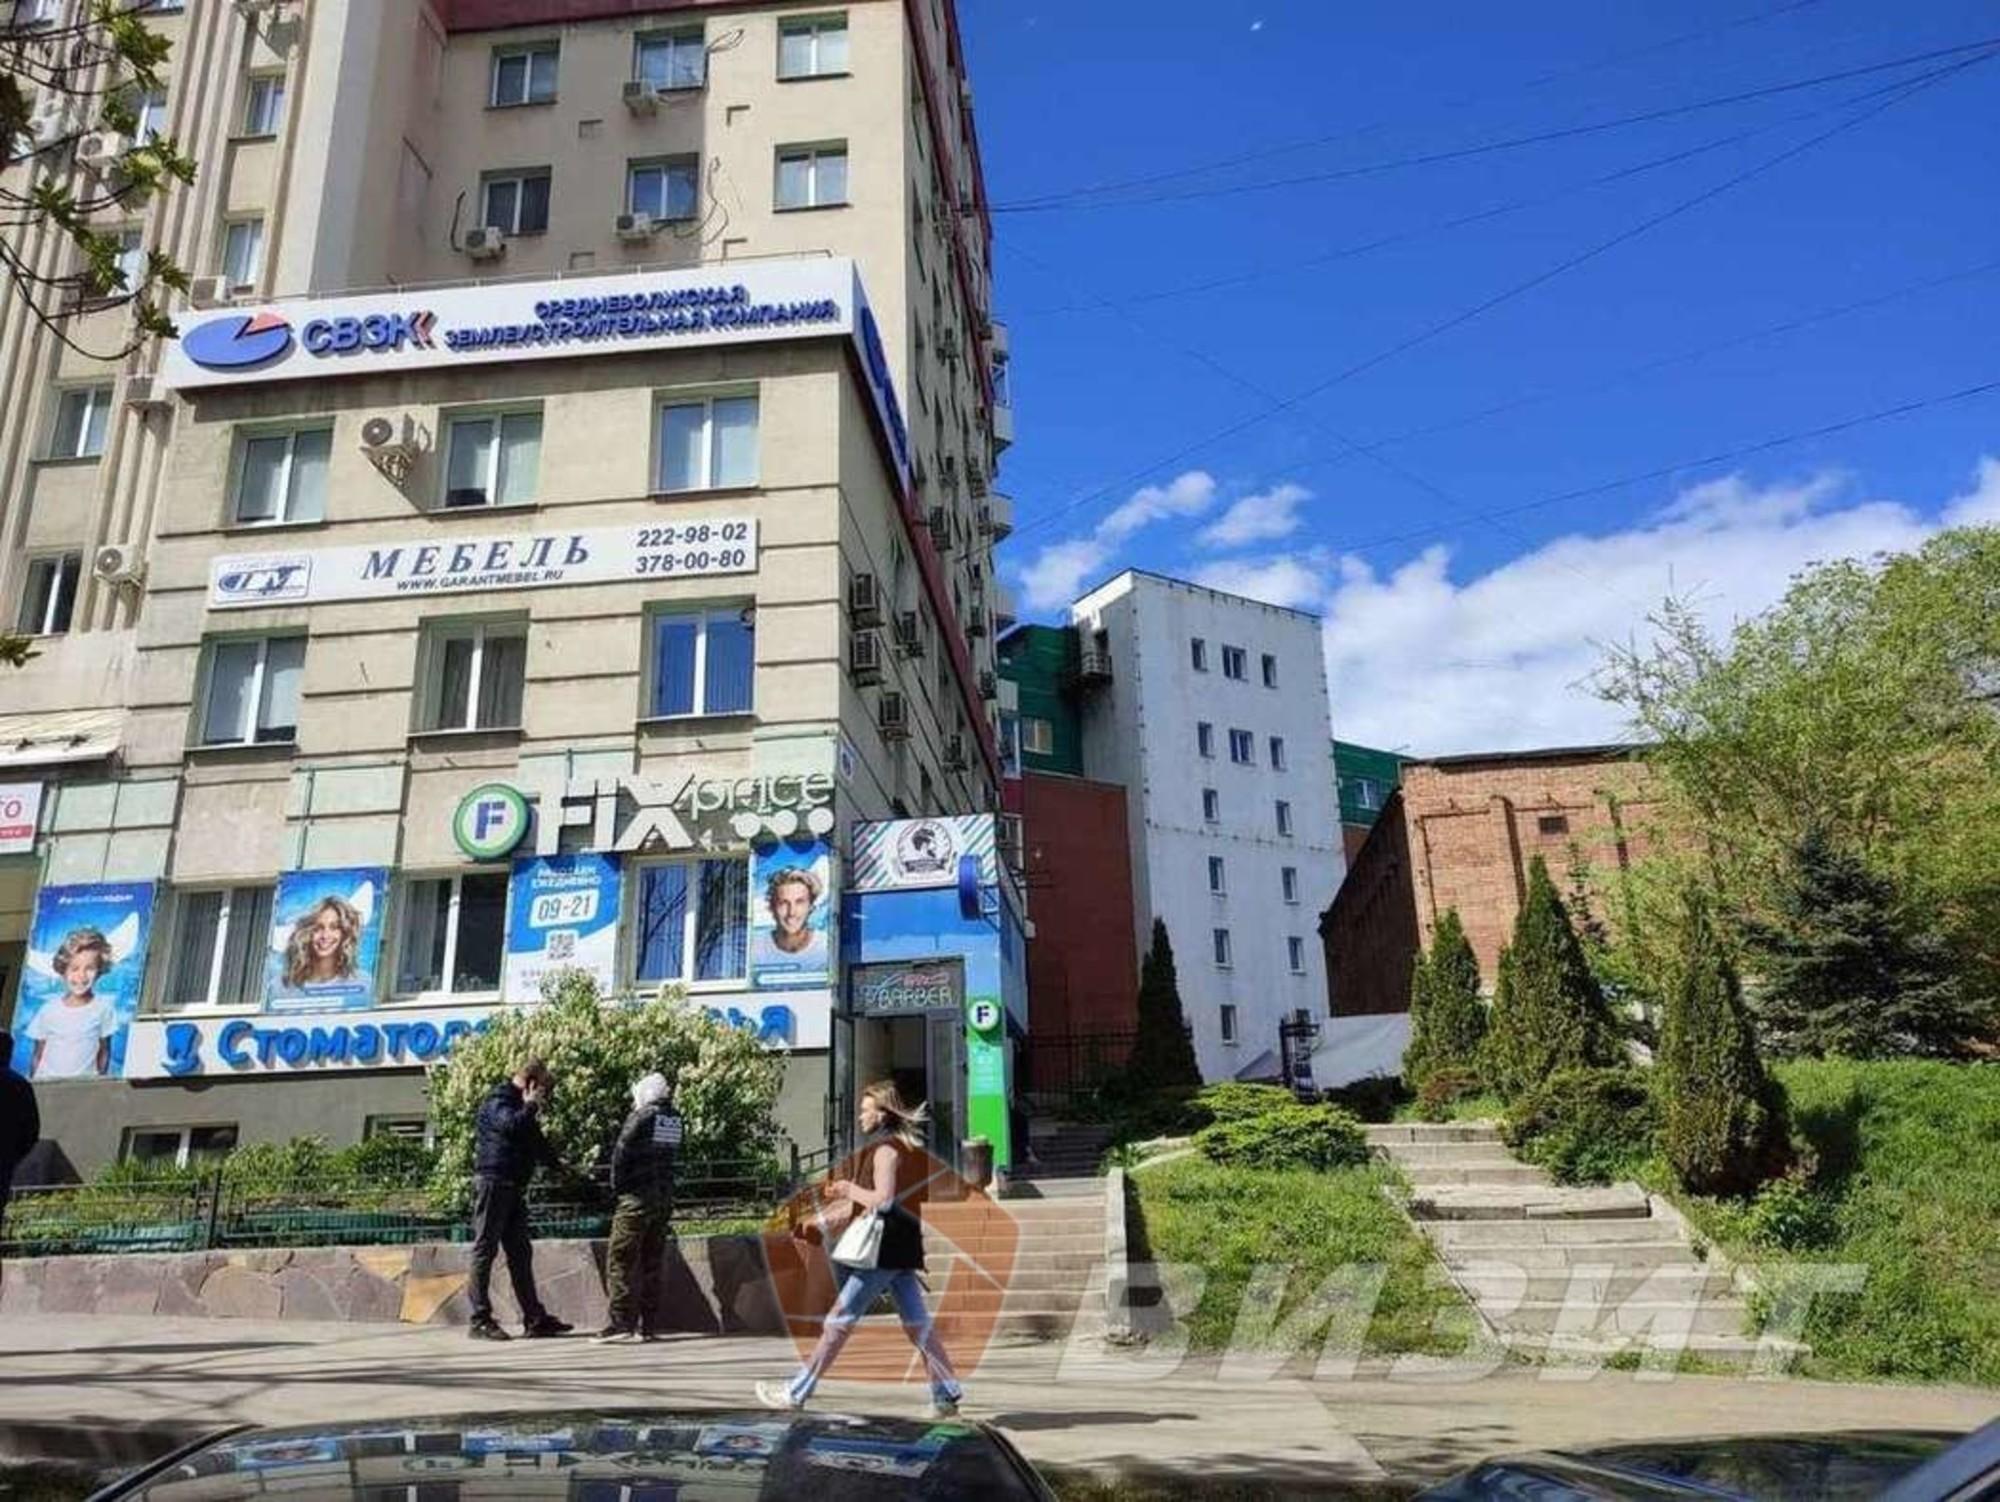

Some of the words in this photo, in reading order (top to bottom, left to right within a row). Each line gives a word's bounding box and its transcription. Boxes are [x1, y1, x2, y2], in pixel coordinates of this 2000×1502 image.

[535, 283, 748, 320] СРЕДНЕВОЛЖСКАЯ
[444, 309, 703, 352] ЗЕМЛЕУСТРОИТЕЛЬНАЯ
[709, 298, 839, 330] КОМПАНИЯ
[636, 523, 748, 548] 222-98-02
[361, 536, 590, 581] МЕБЕЛЬ
[636, 549, 746, 574] 378-00-80
[397, 569, 564, 591] WWW.GARANTMEBEL.RU
[537, 895, 591, 921] 09-21
[977, 1005, 990, 1024] F
